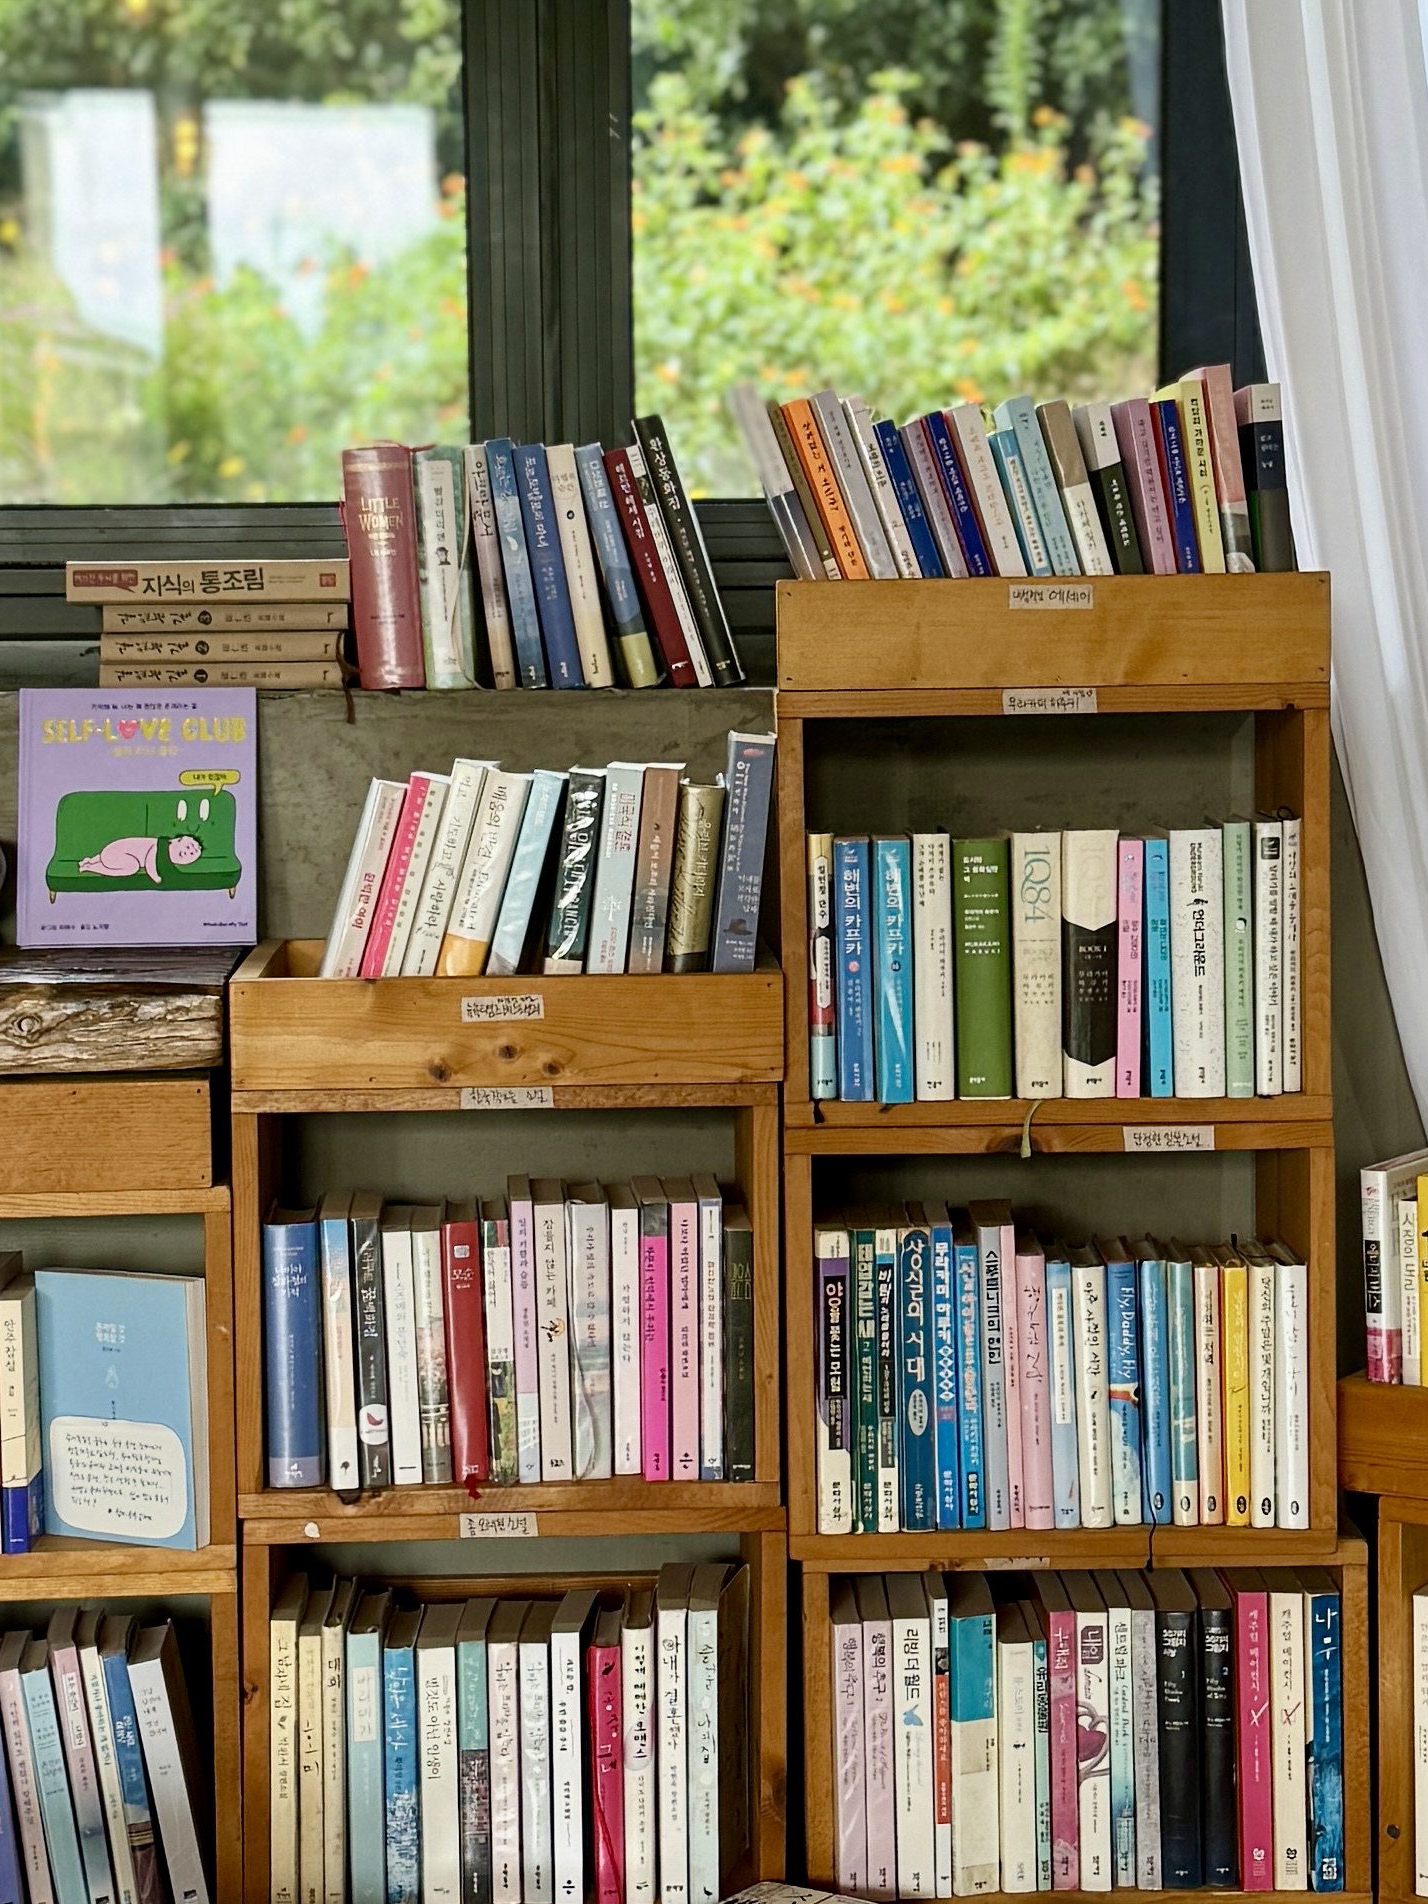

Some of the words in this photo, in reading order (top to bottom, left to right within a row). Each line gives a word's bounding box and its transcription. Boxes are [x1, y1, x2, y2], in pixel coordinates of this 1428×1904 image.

[359, 513, 404, 529] WOMEN
[200, 567, 264, 595] 통조림
[487, 786, 507, 827] 배움의
[843, 868, 860, 910] 해변의
[1022, 846, 1054, 924] 1Q84
[1269, 865, 1278, 896] 달리기를
[844, 915, 862, 955] 카프카
[886, 915, 903, 955] 카프카
[1193, 909, 1205, 977] 언더그라운드
[904, 1238, 926, 1320] 상실의
[1120, 1287, 1135, 1308] Fly,
[1119, 1311, 1135, 1356] Daddy,
[906, 1329, 926, 1383] 시대
[1087, 1352, 1101, 1377] 시간
[1119, 1360, 1134, 1379] Fly
[872, 1633, 886, 1669] 행복의
[903, 1628, 920, 1655] 리빙
[1082, 1629, 1102, 1662] 내일
[904, 1658, 919, 1672] 더
[904, 1674, 920, 1701] 월드
